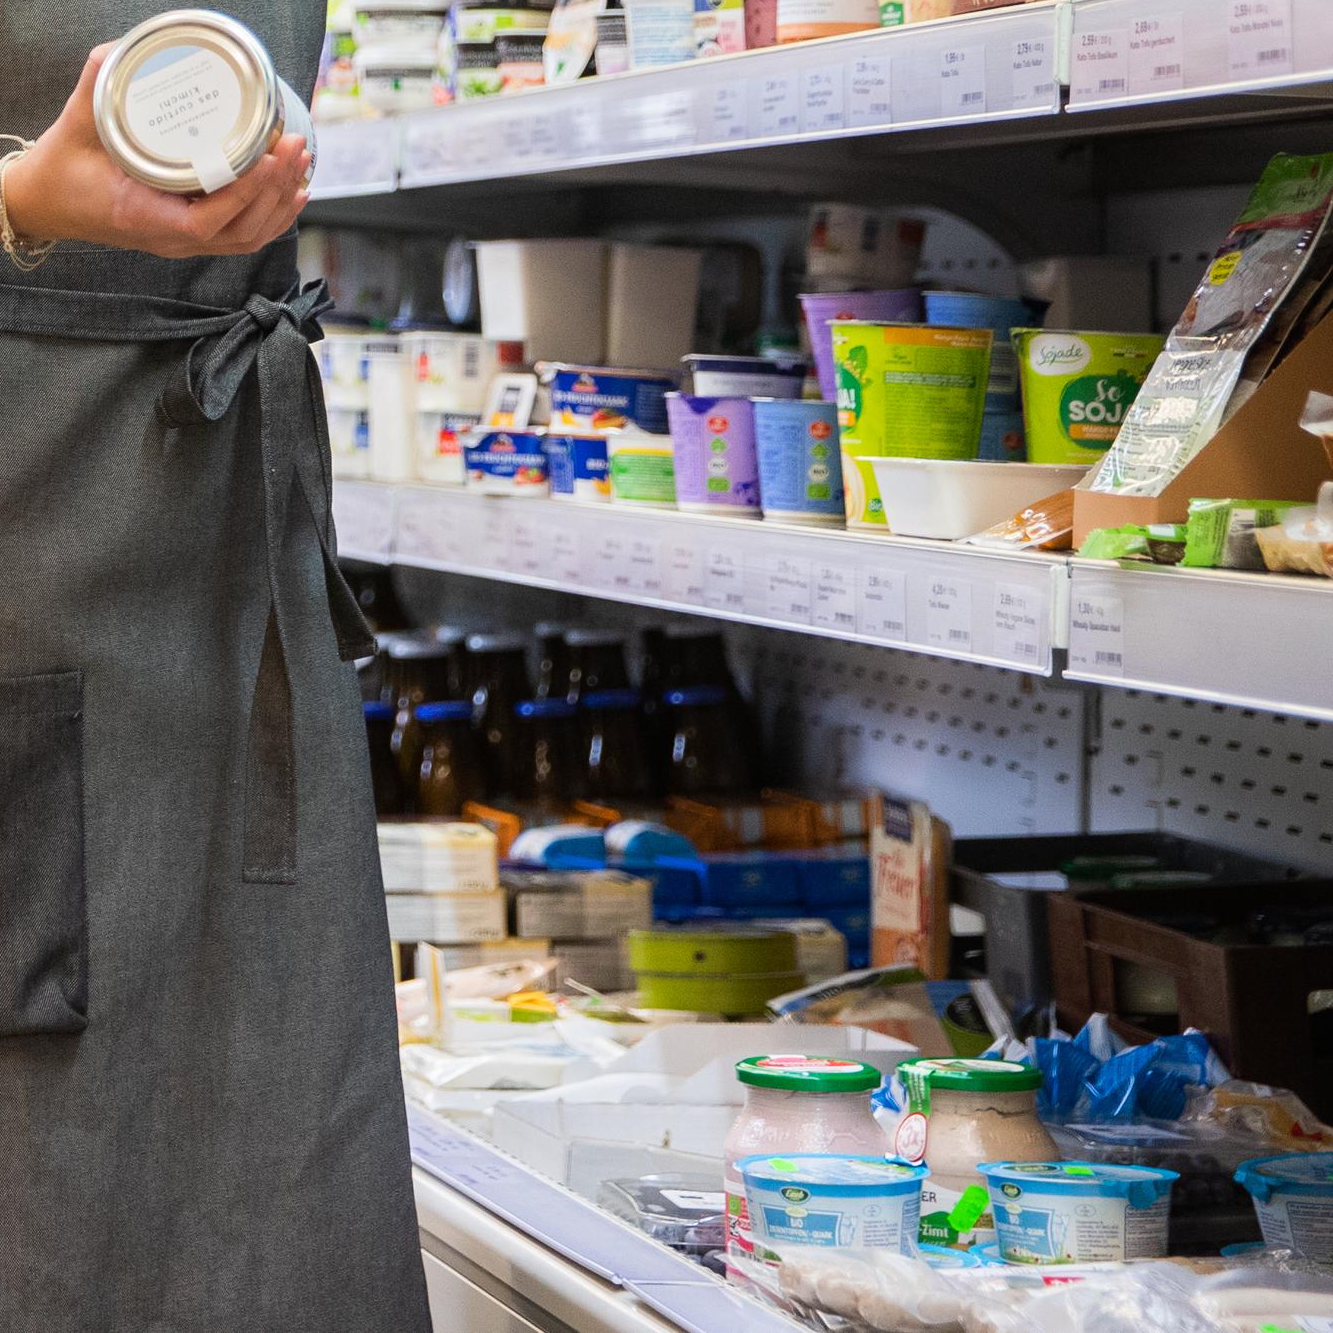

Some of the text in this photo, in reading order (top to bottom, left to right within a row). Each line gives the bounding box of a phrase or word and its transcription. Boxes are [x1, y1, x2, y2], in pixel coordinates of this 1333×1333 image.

[148, 89, 220, 127] das curtido
[158, 86, 200, 111] kimchi
[1038, 343, 1084, 366] Sojade
[1095, 378, 1126, 402] So
